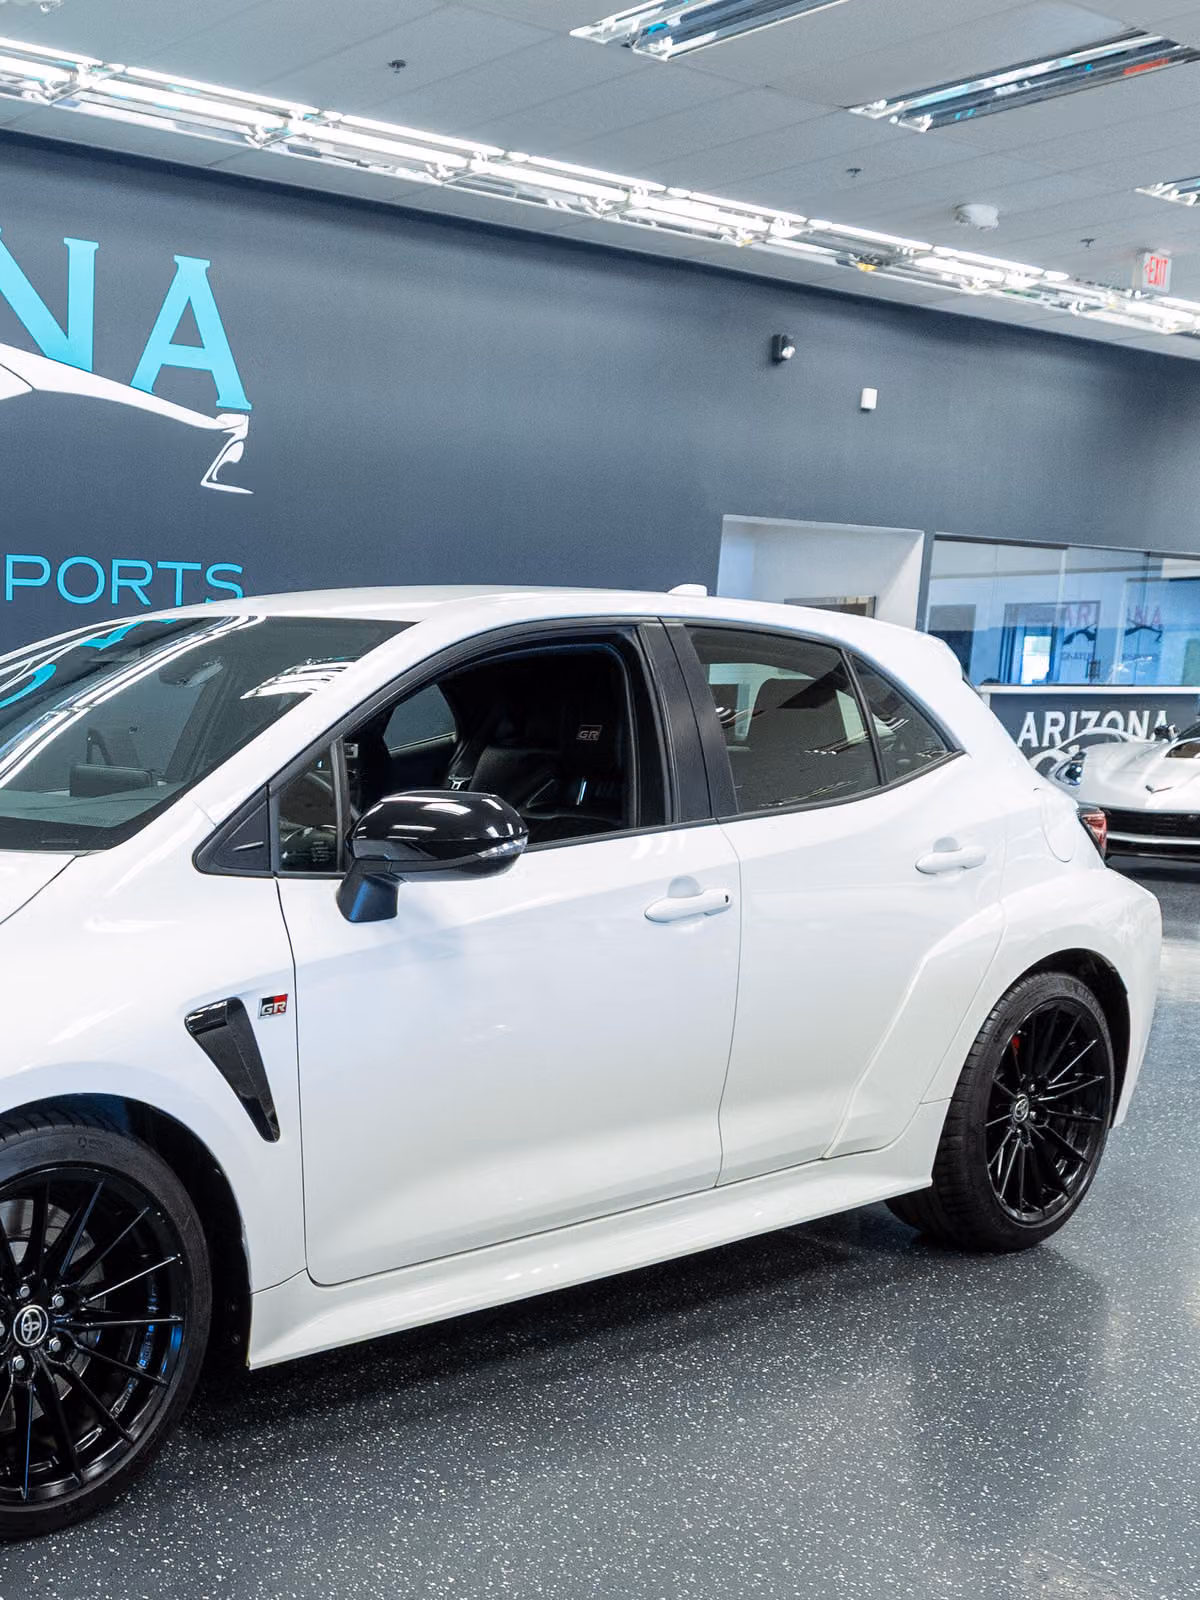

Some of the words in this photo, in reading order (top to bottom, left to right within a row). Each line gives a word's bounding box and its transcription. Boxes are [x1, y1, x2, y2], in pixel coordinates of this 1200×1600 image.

[1148, 256, 1168, 288] EXIT
[579, 729, 601, 739] GR
[1017, 709, 1168, 748] ARIZONA
[261, 1001, 287, 1015] GR
